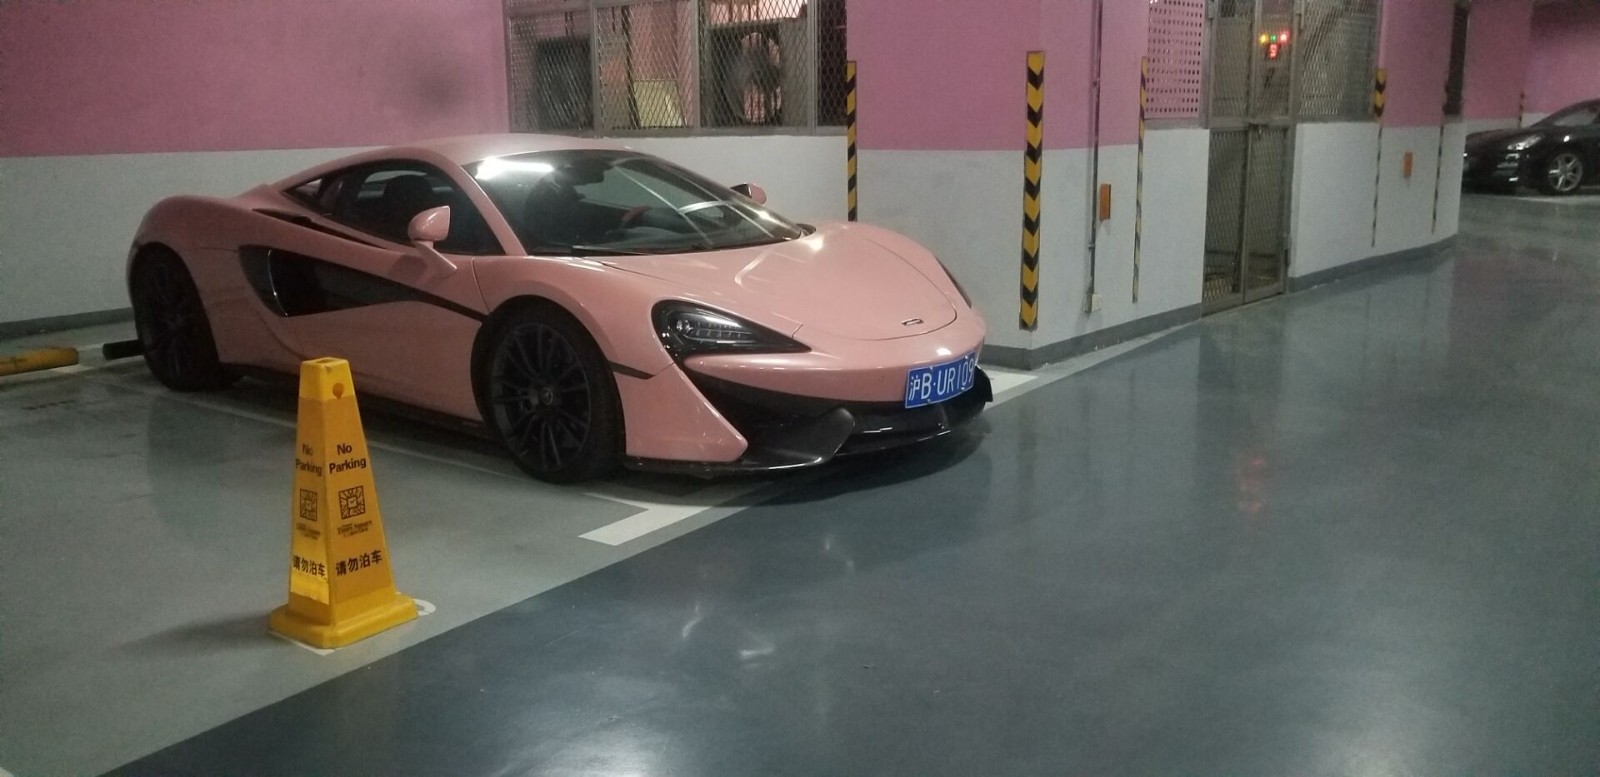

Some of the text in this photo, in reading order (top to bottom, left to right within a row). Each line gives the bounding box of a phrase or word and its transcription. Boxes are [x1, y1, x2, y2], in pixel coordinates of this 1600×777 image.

[302, 443, 313, 456] No
[337, 443, 352, 455] No
[296, 458, 322, 477] Parking
[329, 458, 366, 474] Parking
[293, 555, 326, 577] 请勿泊车
[335, 549, 382, 576] 请勿泊车
